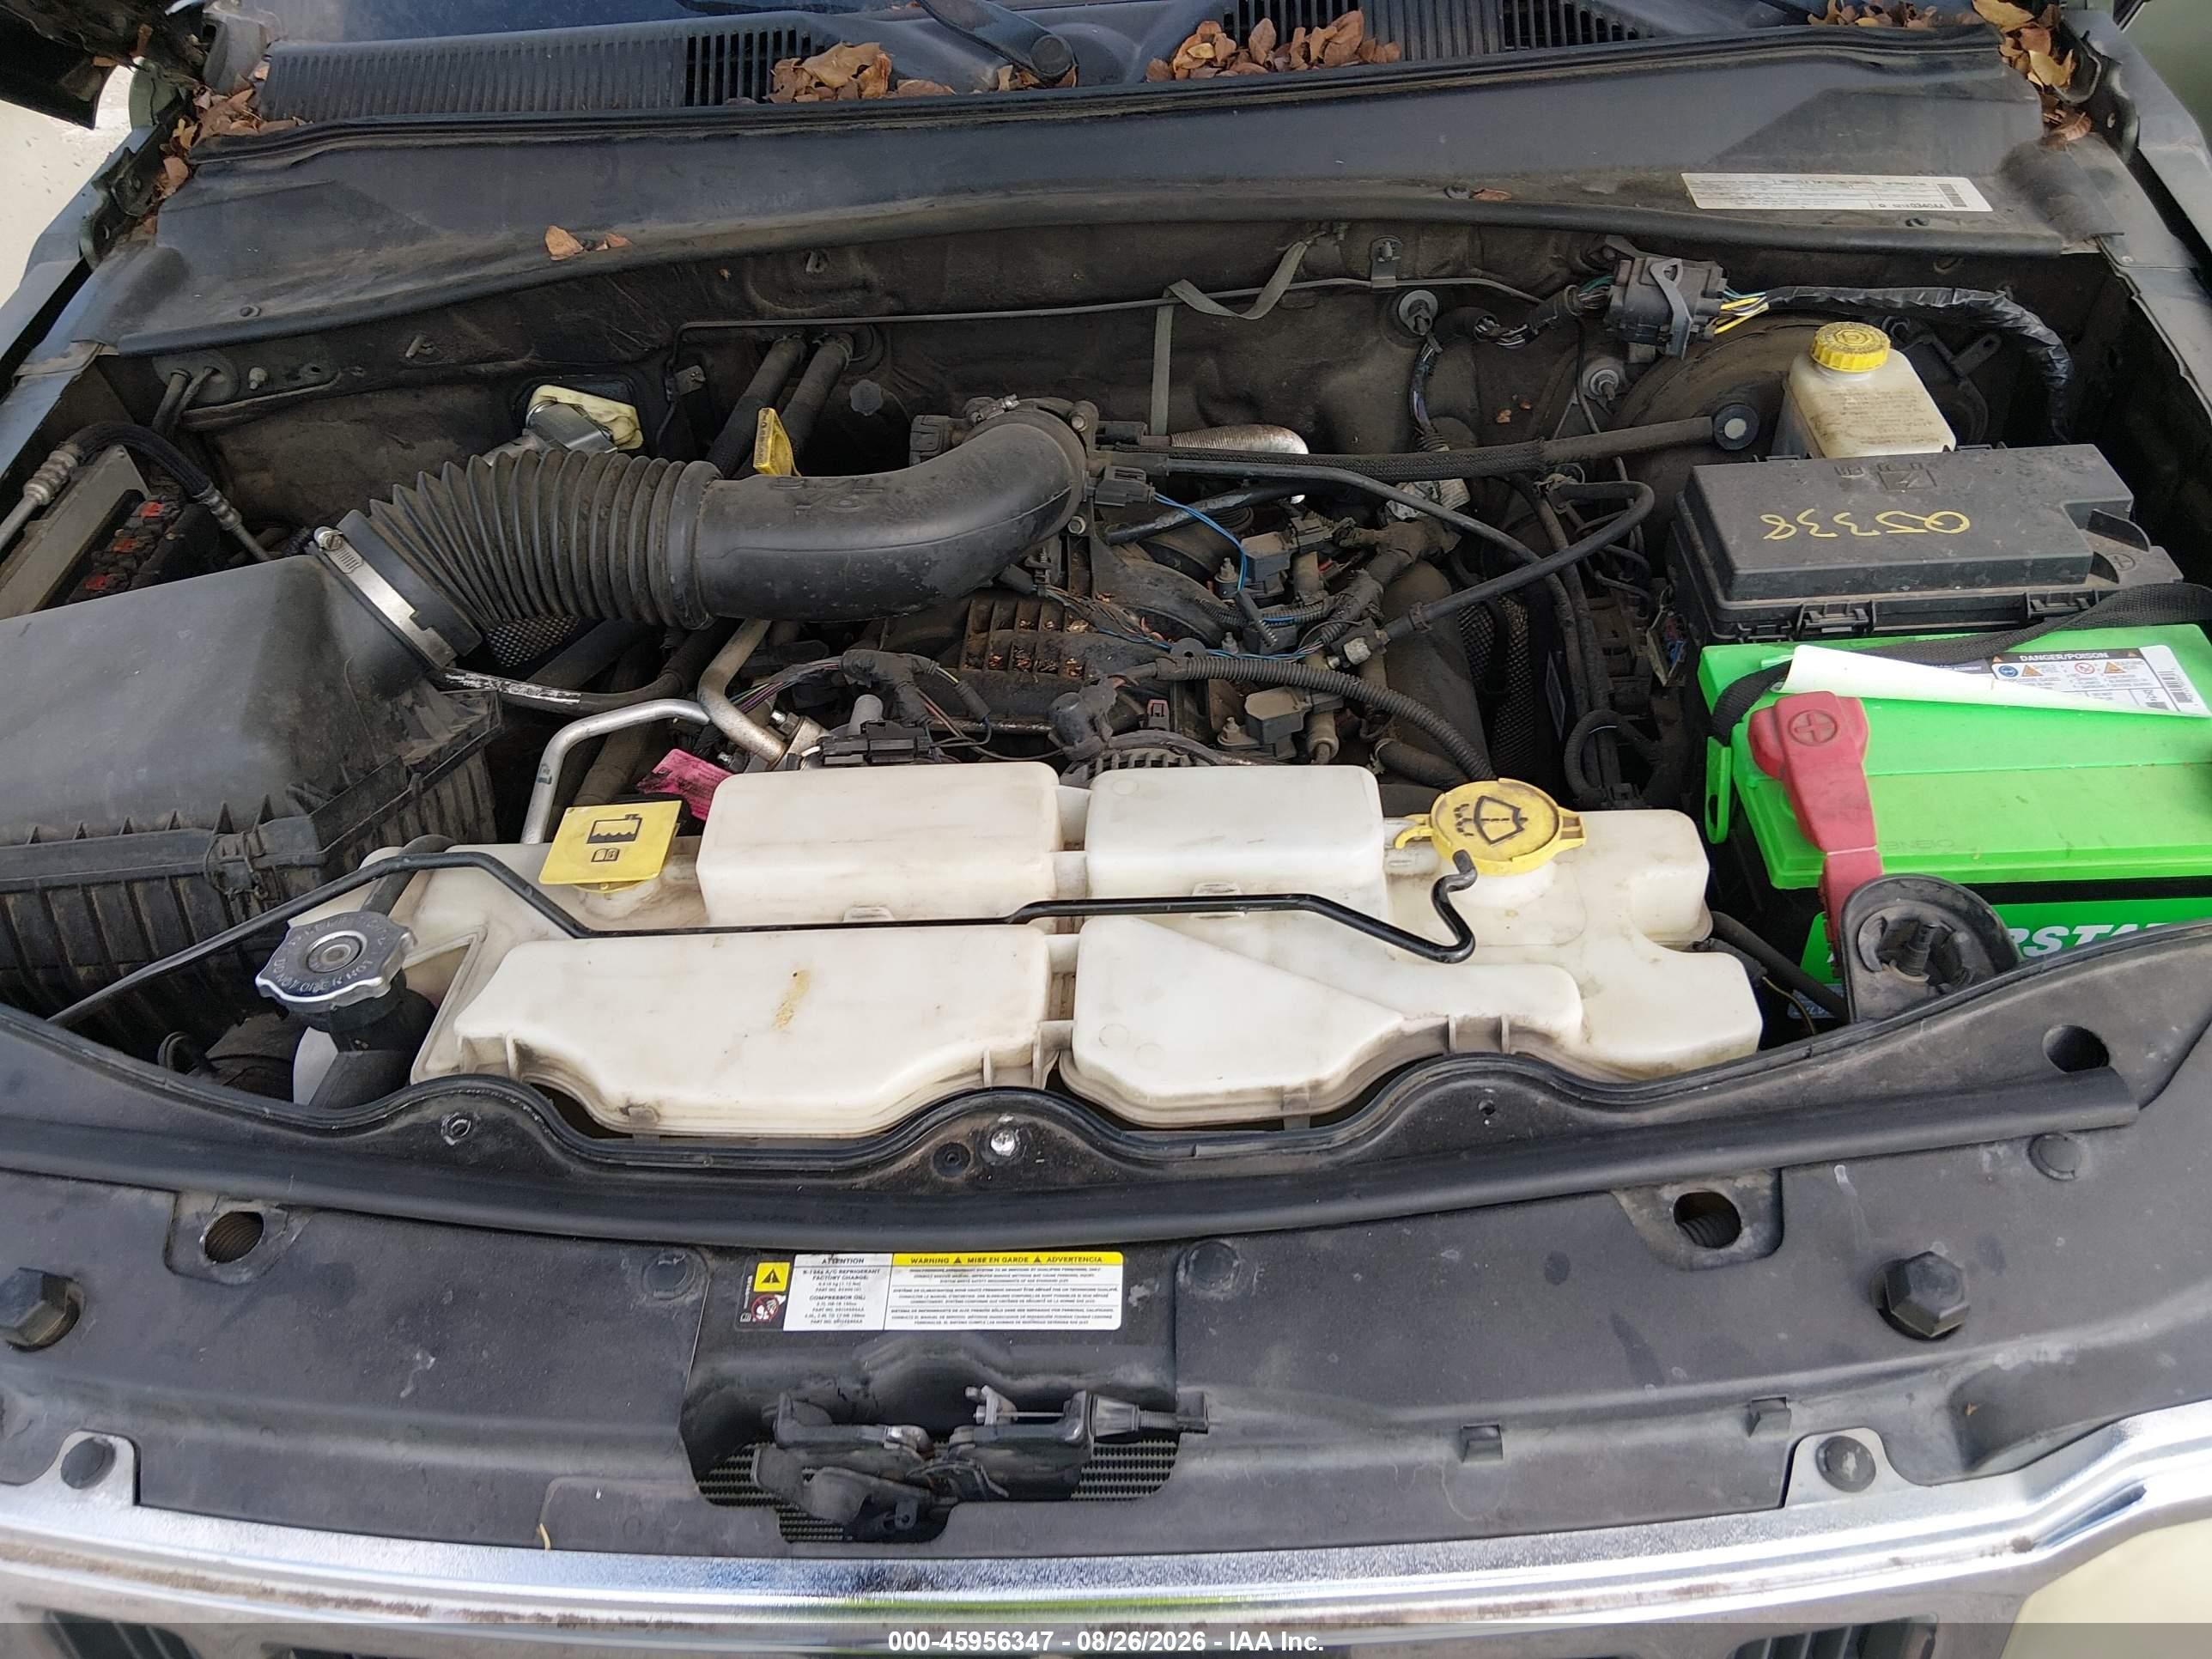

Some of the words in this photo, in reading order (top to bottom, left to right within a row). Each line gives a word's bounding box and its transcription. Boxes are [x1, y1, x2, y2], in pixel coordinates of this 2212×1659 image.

[2020, 652, 2109, 662] DANGER/POISON
[910, 1256, 950, 1265] WARNING
[1047, 1255, 1103, 1264] ADVERTENCIA
